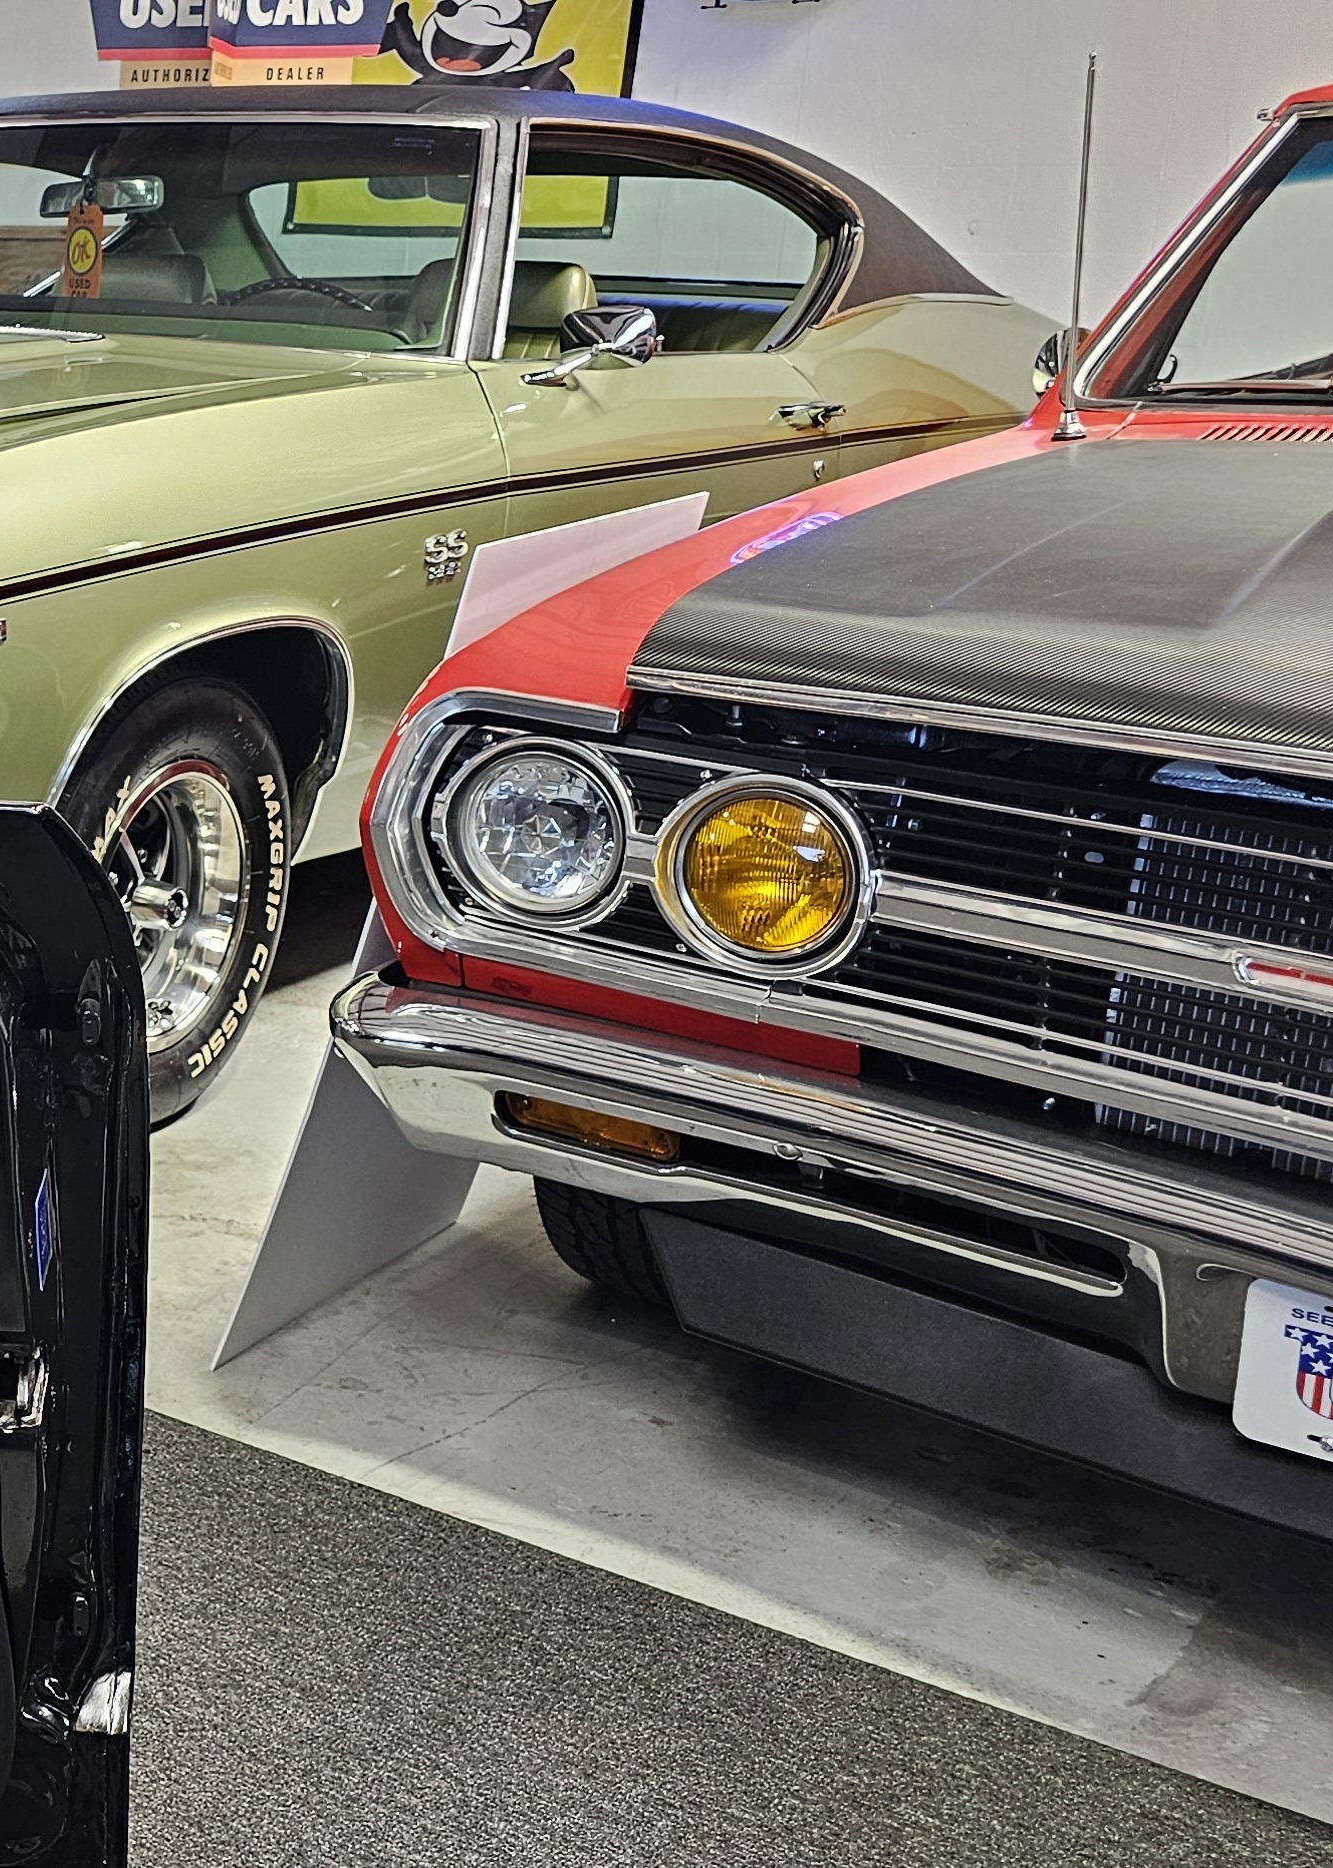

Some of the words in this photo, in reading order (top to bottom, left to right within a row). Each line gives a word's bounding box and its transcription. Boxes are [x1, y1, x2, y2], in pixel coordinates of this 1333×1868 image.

[120, 0, 210, 28] USE
[246, 0, 364, 26] CARS
[131, 69, 210, 82] AUTHORIZ
[266, 67, 325, 80] DEALER
[72, 236, 91, 265] OK
[69, 278, 92, 290] USED
[424, 529, 469, 563] SS
[257, 774, 285, 932] MAXGRIP
[187, 943, 269, 1078] CLASSIC
[1290, 1307, 1333, 1328] SEE
